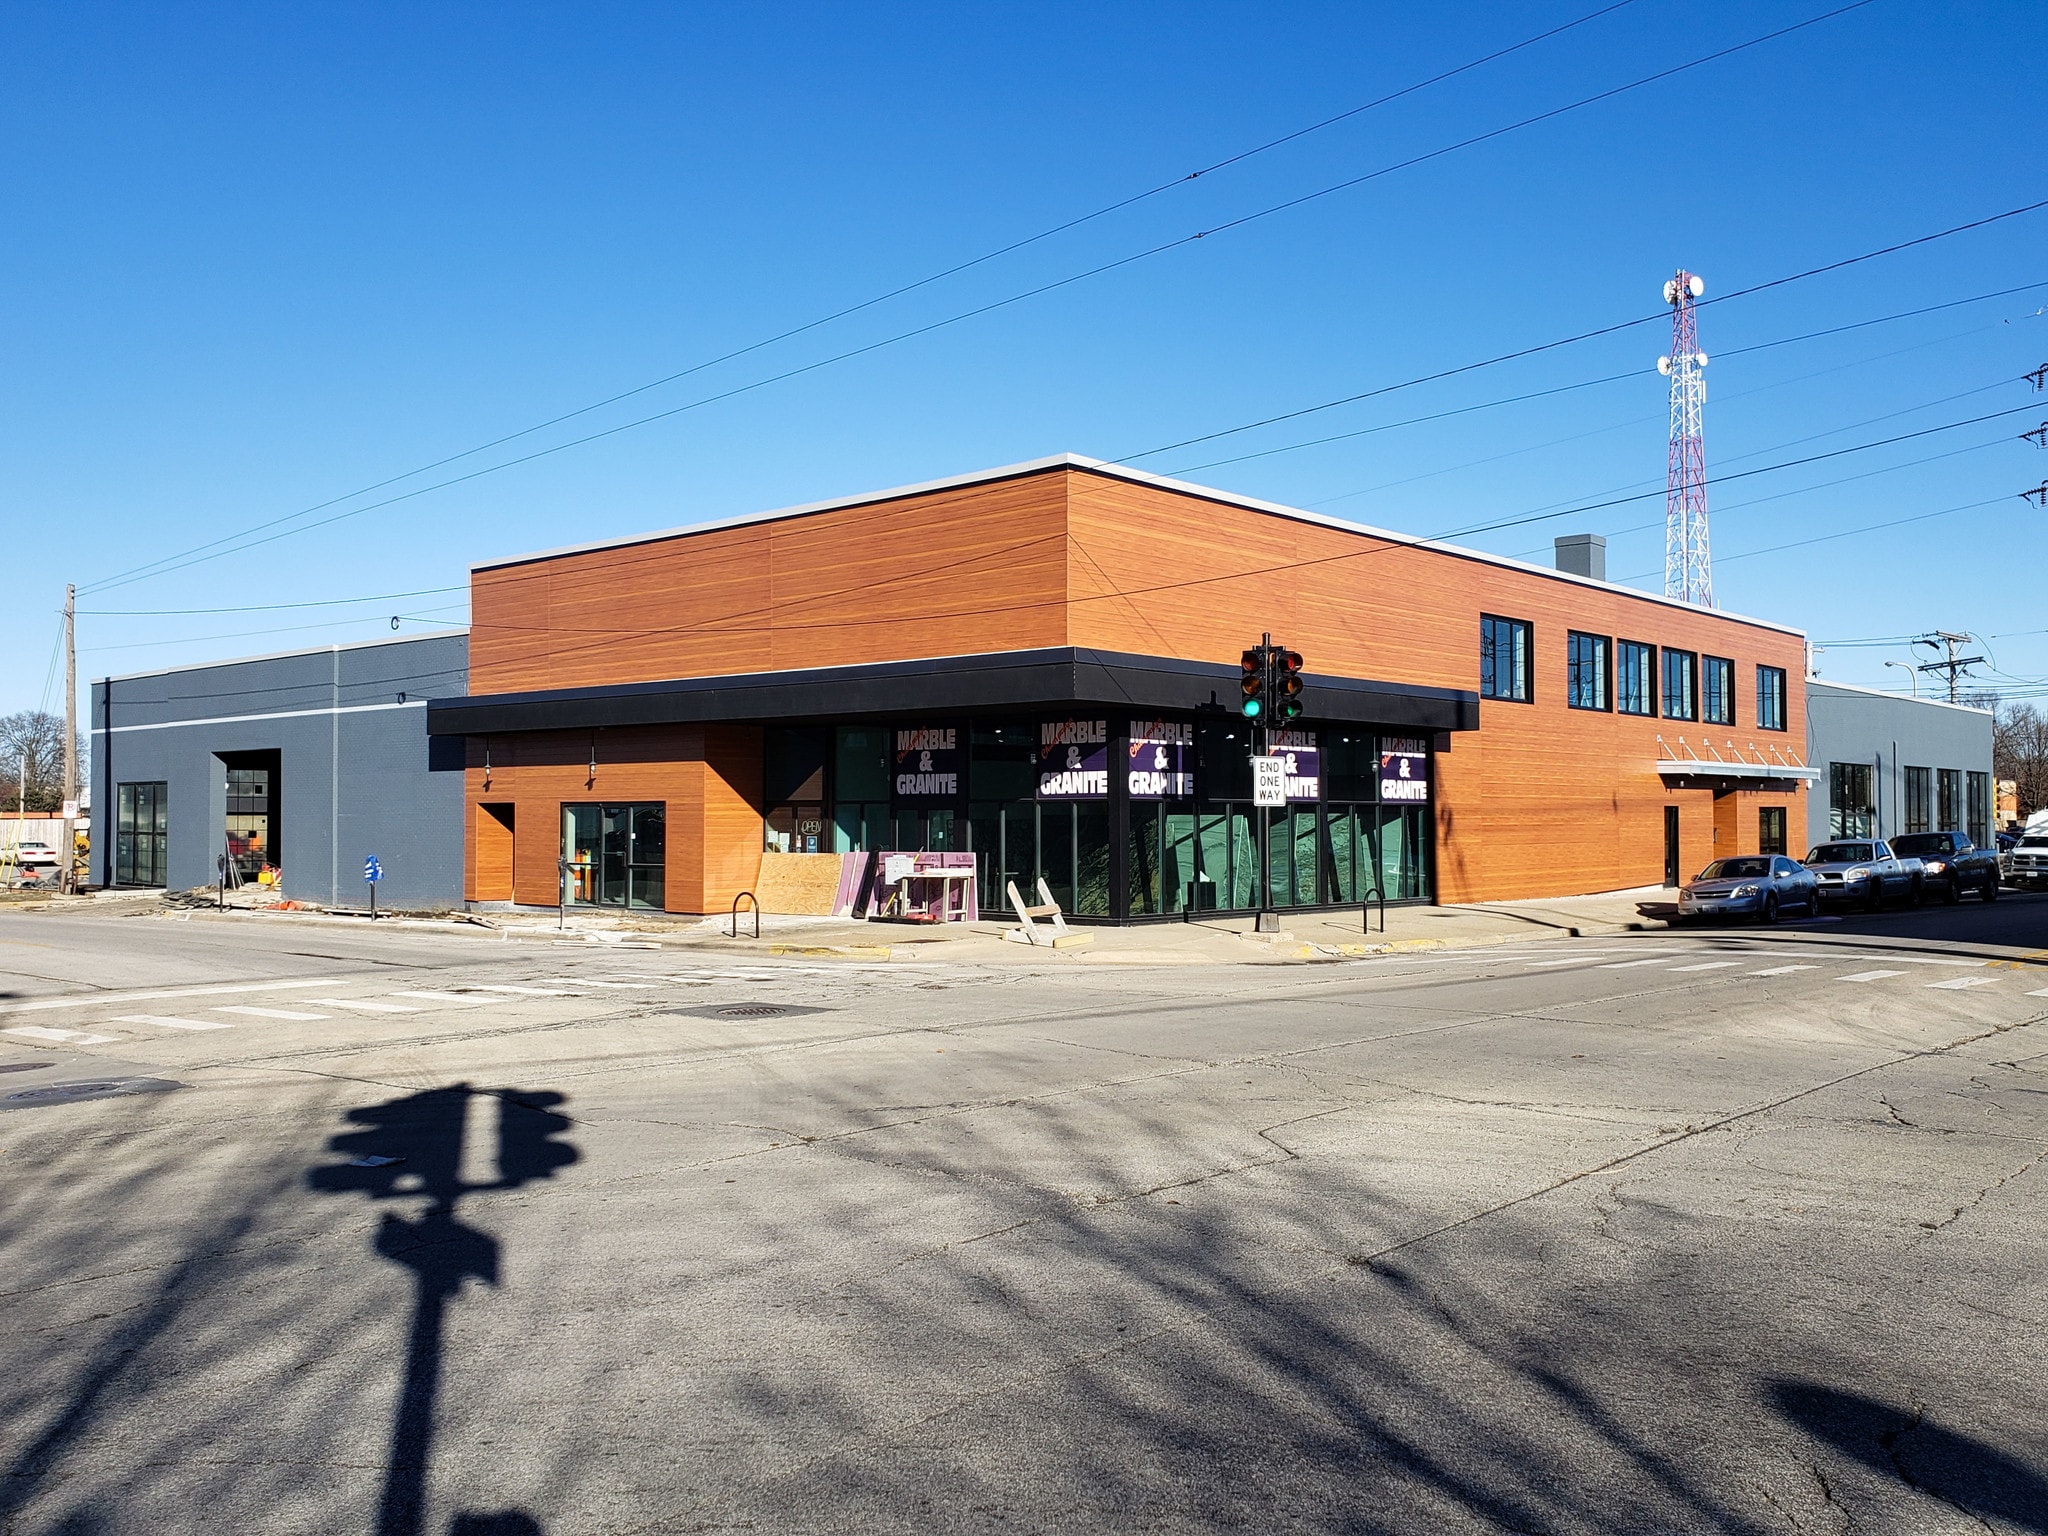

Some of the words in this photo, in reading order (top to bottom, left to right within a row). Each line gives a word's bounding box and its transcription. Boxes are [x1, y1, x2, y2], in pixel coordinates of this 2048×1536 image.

[897, 729, 956, 751] MARBLE
[1042, 720, 1106, 745] MARBLE
[1130, 720, 1193, 746] MARBLE
[1066, 746, 1082, 769] &
[1154, 746, 1170, 770] &
[1382, 737, 1426, 758] MARBLE
[919, 750, 933, 772] &
[1260, 762, 1280, 773] END
[1285, 753, 1298, 774] &
[1399, 758, 1411, 778] &
[896, 773, 957, 795] GRANITE
[1040, 770, 1108, 795] GRANITE
[1128, 770, 1194, 795] GRANITE
[1260, 776, 1280, 787] ONE
[1381, 779, 1427, 800] GRANITE
[1259, 790, 1280, 801] WAY
[801, 820, 821, 832] OPEN
